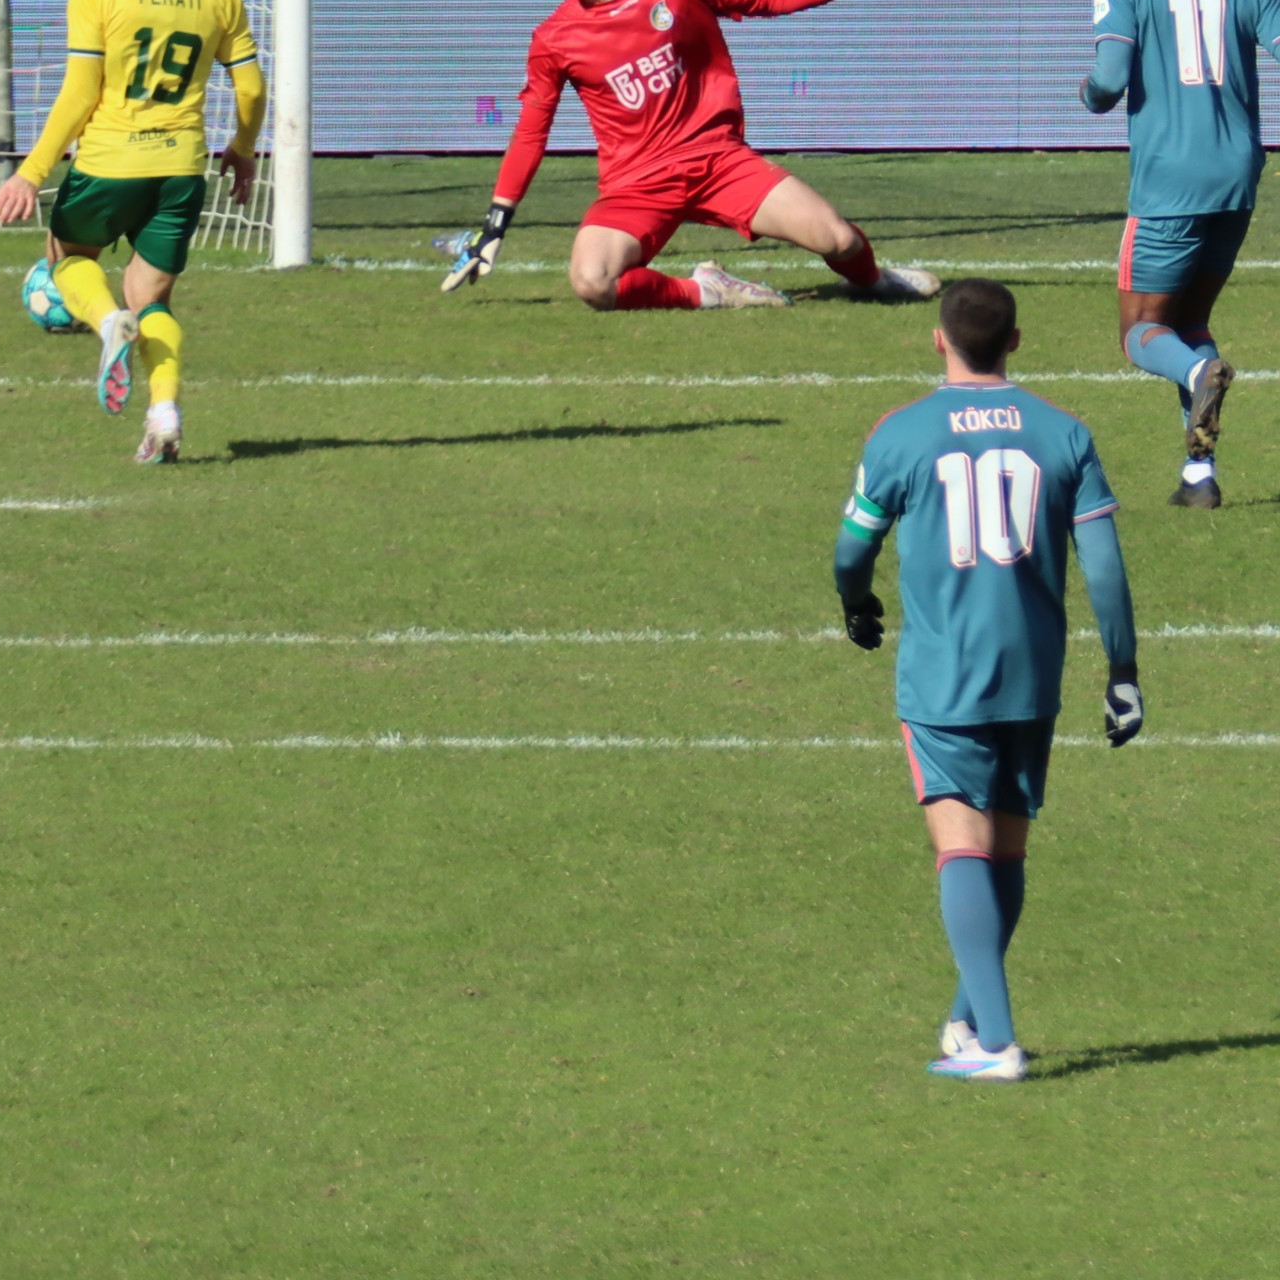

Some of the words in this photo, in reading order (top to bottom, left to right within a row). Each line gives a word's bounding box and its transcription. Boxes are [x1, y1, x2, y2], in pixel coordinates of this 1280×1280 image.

[125, 26, 203, 105] 19
[636, 43, 675, 77] BET
[647, 57, 684, 94] CITY
[937, 448, 1041, 568] 10
